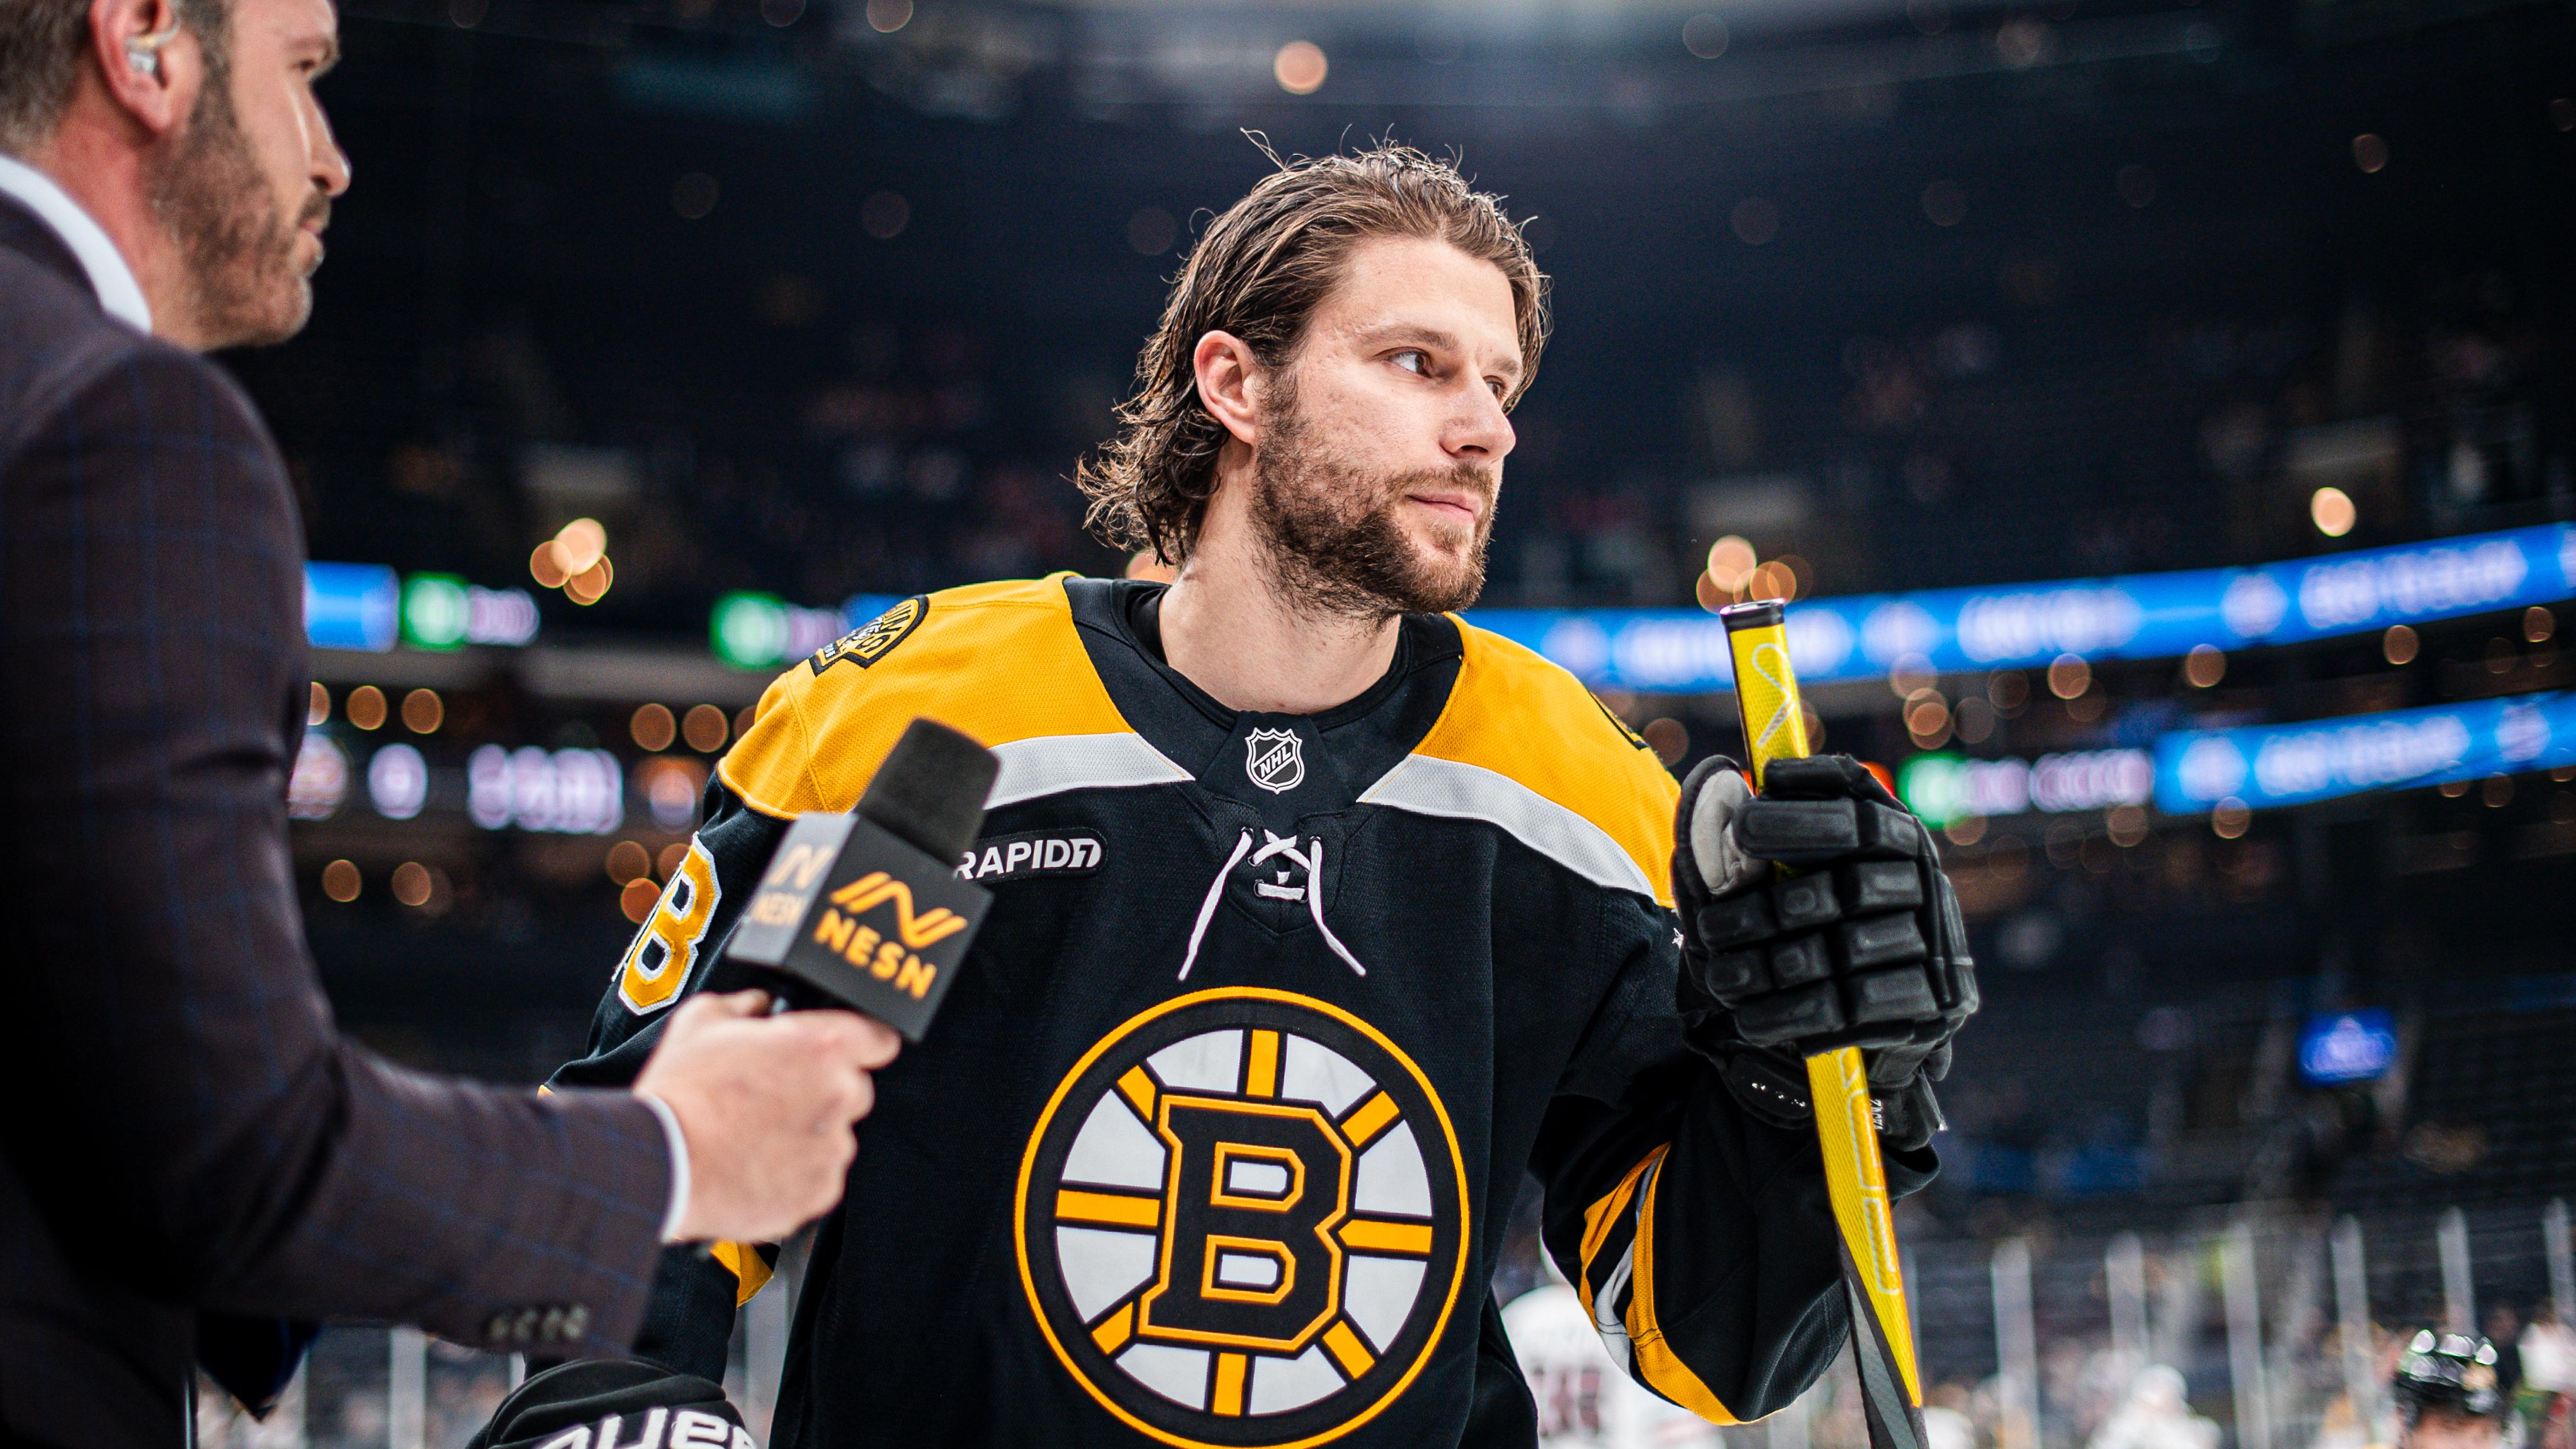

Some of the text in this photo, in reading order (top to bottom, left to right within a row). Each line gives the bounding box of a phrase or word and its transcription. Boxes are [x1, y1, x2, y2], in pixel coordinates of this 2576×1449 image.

[1260, 746, 1291, 778] NHL
[612, 830, 722, 1016] 8
[814, 907, 937, 1000] NESN
[1138, 1094, 1352, 1352] B
